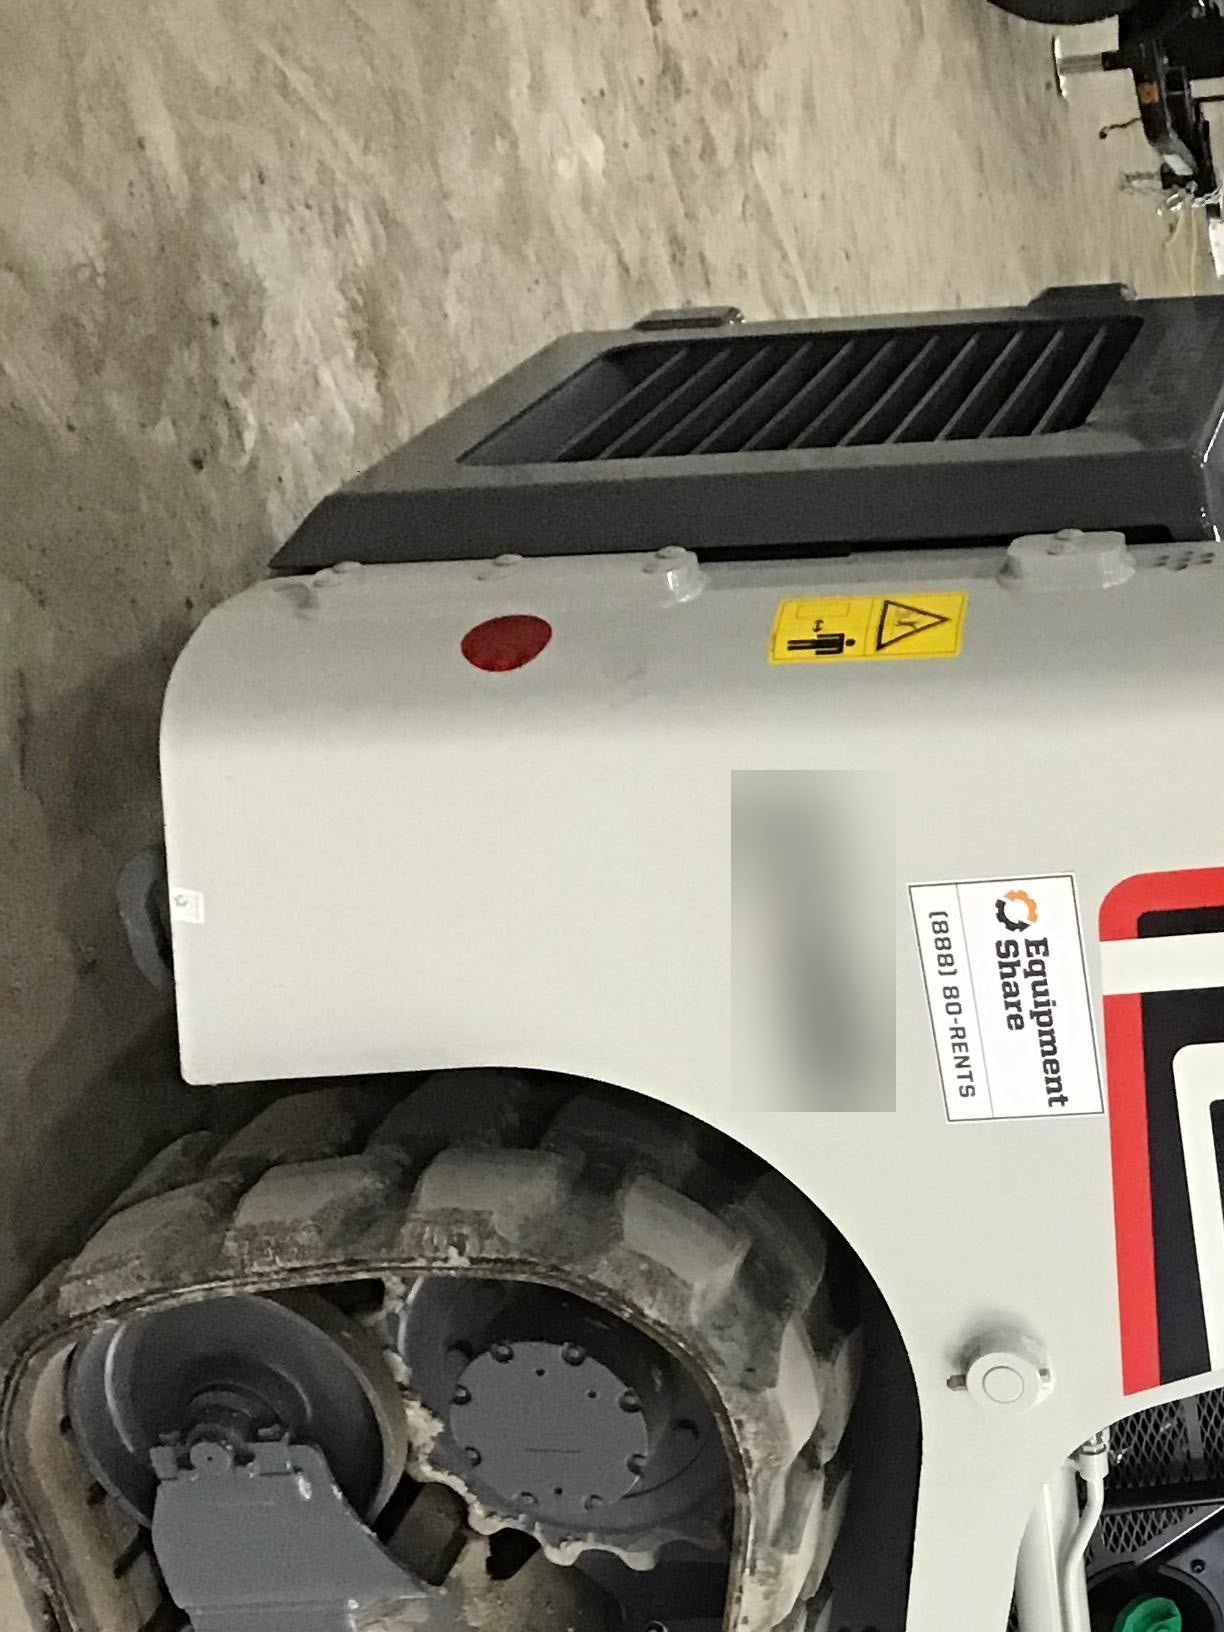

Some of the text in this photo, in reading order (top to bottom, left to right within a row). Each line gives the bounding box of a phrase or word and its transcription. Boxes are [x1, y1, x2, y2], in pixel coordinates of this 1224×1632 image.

[928, 911, 976, 1098] (888) 80-RENTS
[995, 939, 1025, 1031] Share
[1023, 937, 1069, 1107] Equipment
